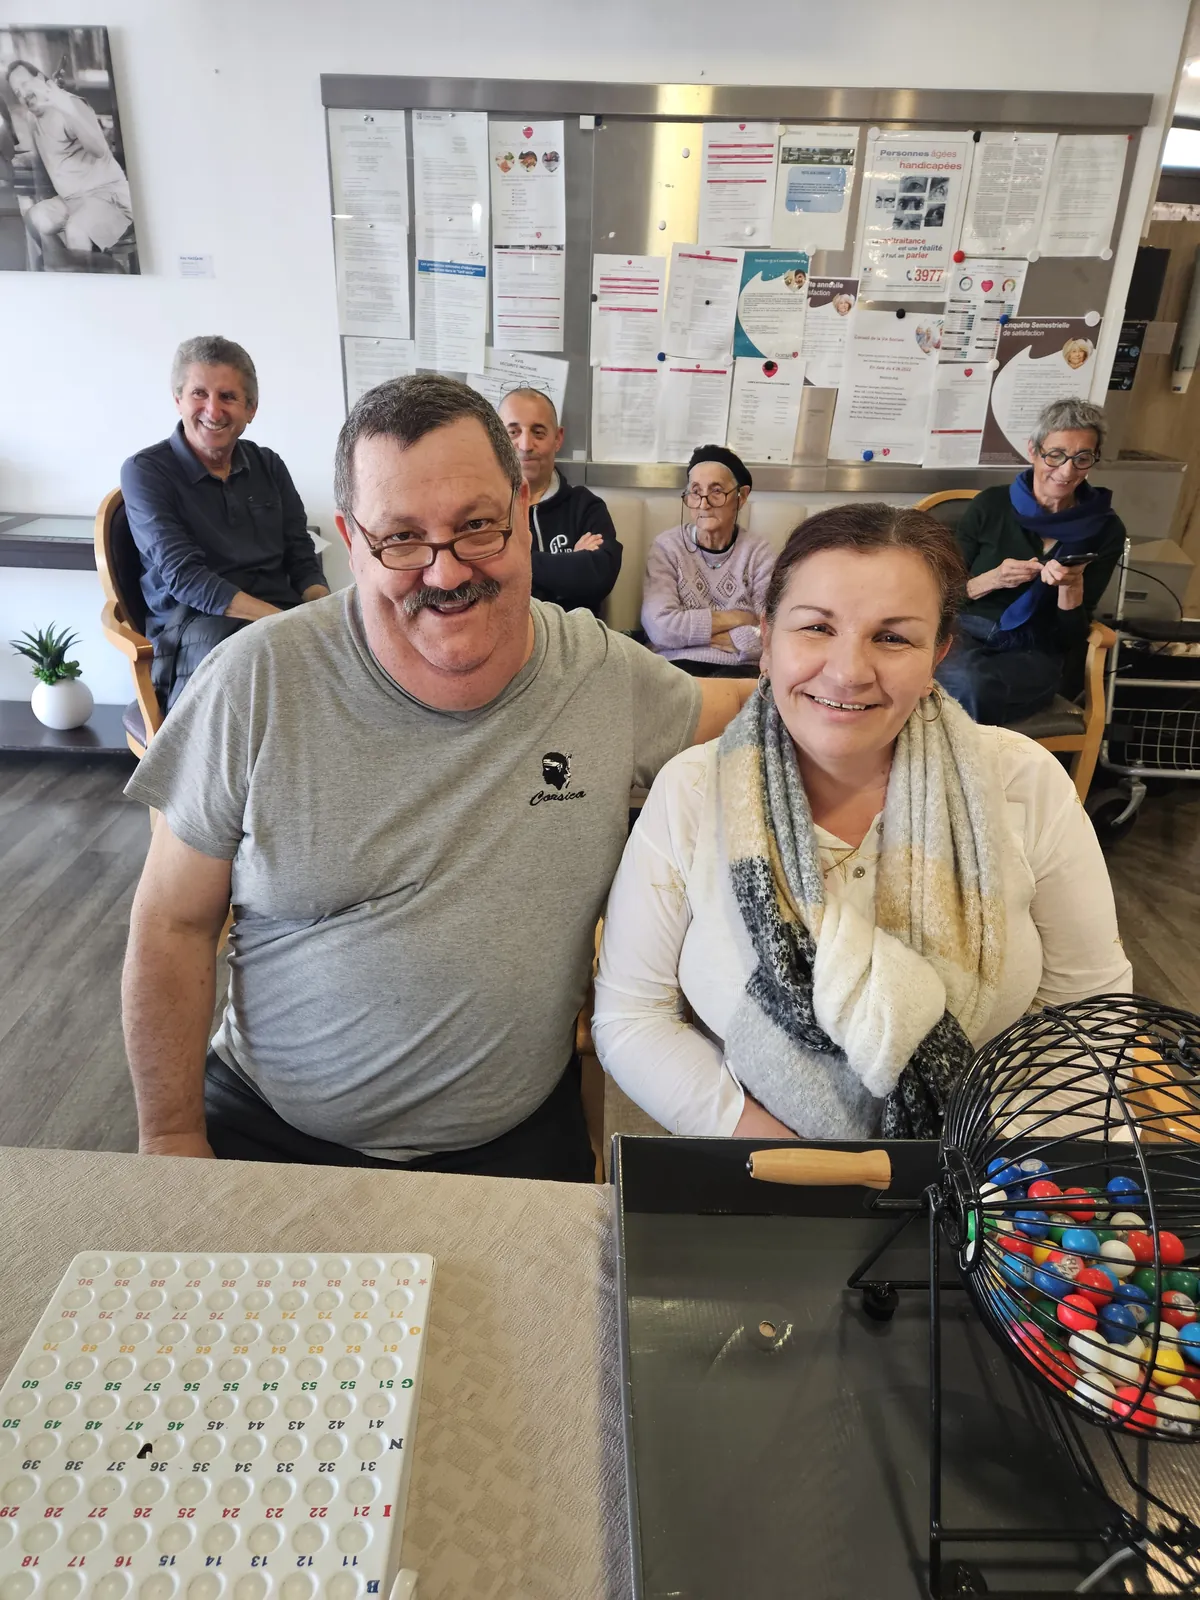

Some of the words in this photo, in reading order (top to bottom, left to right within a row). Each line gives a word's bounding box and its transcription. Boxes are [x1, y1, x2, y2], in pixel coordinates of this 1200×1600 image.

[900, 160, 962, 170] handicapées
[914, 268, 944, 282] 3977
[529, 790, 586, 806] Corsica
[257, 1280, 271, 1288] 85
[135, 1312, 150, 1320] 78
[209, 1312, 224, 1320] 76
[245, 1312, 259, 1320] 75
[43, 1342, 58, 1351] 70
[82, 1344, 97, 1352] 69
[157, 1346, 173, 1354] 67
[234, 1346, 248, 1354] 65
[308, 1346, 324, 1354] 63
[384, 1344, 398, 1352] 61
[22, 1380, 39, 1388] 60
[65, 1381, 82, 1390] 59
[104, 1382, 122, 1390] 58
[144, 1383, 161, 1391] 57
[184, 1383, 200, 1391] 56
[223, 1383, 239, 1391] 55
[262, 1382, 278, 1391] 54
[301, 1382, 317, 1390] 53
[340, 1381, 356, 1390] 52
[379, 1380, 394, 1388] 51
[402, 1379, 413, 1388] G
[2, 1419, 21, 1428] 50
[44, 1420, 62, 1429] 49
[85, 1421, 102, 1430] 48
[125, 1422, 144, 1430] 47
[167, 1422, 184, 1430] 46
[207, 1421, 224, 1430] 45
[248, 1421, 265, 1430] 44
[288, 1421, 305, 1430] 43
[328, 1420, 345, 1430] 42
[369, 1420, 384, 1428] 41
[389, 1438, 403, 1449] N
[22, 1460, 41, 1470] 39
[65, 1461, 84, 1470] 38
[106, 1462, 126, 1471] 37
[150, 1462, 168, 1472] 36
[192, 1462, 210, 1472] 35
[235, 1463, 252, 1472] 34
[276, 1463, 294, 1472] 33
[318, 1462, 336, 1472] 32
[360, 1462, 376, 1471] 31
[0, 1507, 19, 1517] 29
[44, 1507, 64, 1518] 28
[88, 1508, 108, 1518] 27
[134, 1508, 152, 1518] 26
[178, 1508, 196, 1518] 25
[222, 1508, 240, 1518] 24
[266, 1508, 284, 1518] 23
[310, 1507, 328, 1518] 22
[354, 1506, 370, 1516] 21
[383, 1505, 391, 1517] I
[21, 1556, 39, 1567] 18
[68, 1556, 85, 1567] 17
[114, 1556, 131, 1567] 16
[159, 1555, 175, 1566] 15
[206, 1556, 221, 1566] 14
[251, 1556, 267, 1567] 13
[297, 1556, 313, 1567] 12
[343, 1556, 358, 1566] 11
[367, 1580, 380, 1593] B
